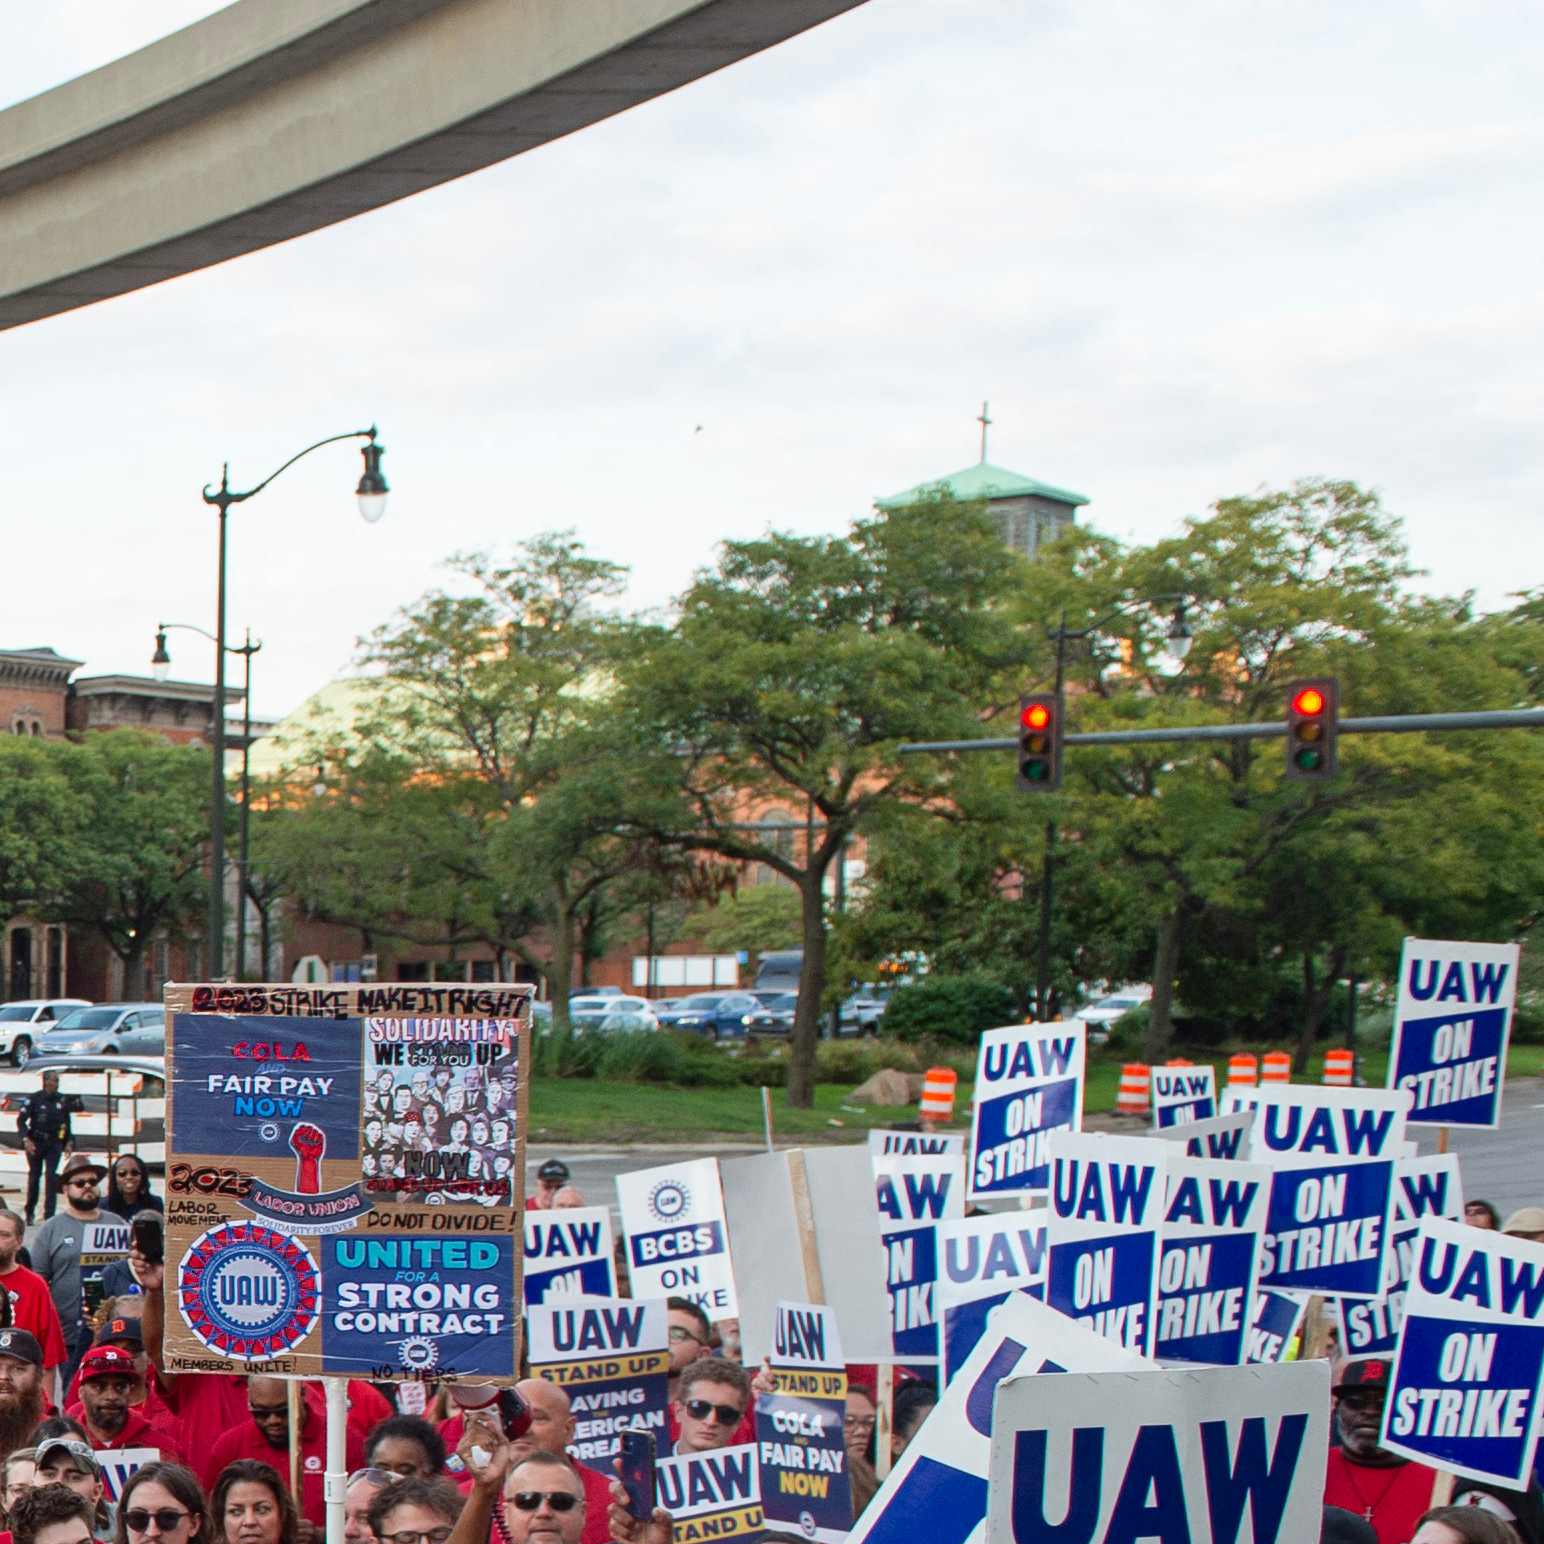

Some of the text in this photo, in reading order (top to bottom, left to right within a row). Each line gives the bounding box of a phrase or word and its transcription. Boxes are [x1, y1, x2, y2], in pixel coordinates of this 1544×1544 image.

[1409, 960, 1508, 1004] UAW
[368, 1018, 507, 1043] SOLIDARITY
[1432, 1019, 1471, 1060] ON
[232, 1042, 310, 1062] COLA
[374, 1043, 404, 1066] WE
[475, 1045, 502, 1065] UP
[984, 1037, 1076, 1081] UAW
[208, 1075, 334, 1096] FAIR PAY
[1157, 1076, 1208, 1096] UAW
[1399, 1040, 1496, 1110] STRIKE
[233, 1098, 304, 1117] NOW
[1005, 1097, 1041, 1137] ON
[1263, 1105, 1396, 1156] UAW
[1054, 1158, 1155, 1225] UAW
[1295, 1174, 1346, 1223] ON
[169, 1203, 216, 1215] LABOR
[257, 1217, 357, 1236] SOLIDARITY FOREVER
[524, 1221, 602, 1259] UAW
[336, 1241, 500, 1269] UNITED
[640, 1229, 714, 1260] BCBS
[1259, 1216, 1381, 1279] STRIKE
[661, 1265, 700, 1290] ON
[1075, 1247, 1114, 1308] ON
[1161, 1244, 1211, 1290] ON
[1420, 1237, 1544, 1317] UAW
[219, 1275, 279, 1306] UAW
[338, 1283, 499, 1310] STRONG
[335, 1313, 503, 1335] CONTRACT
[553, 1307, 645, 1351] UAW
[776, 1308, 825, 1361] UAW
[171, 1356, 297, 1374] MEMBERS UNITE!
[541, 1357, 660, 1384] STAND UP
[1438, 1333, 1496, 1382] ON
[772, 1374, 841, 1393] STAND UP
[773, 1411, 825, 1437] COLA
[1395, 1390, 1528, 1436] STRIKE
[761, 1443, 843, 1473] FAIR PAY
[657, 1453, 751, 1509] UAW
[780, 1472, 829, 1498] NOW
